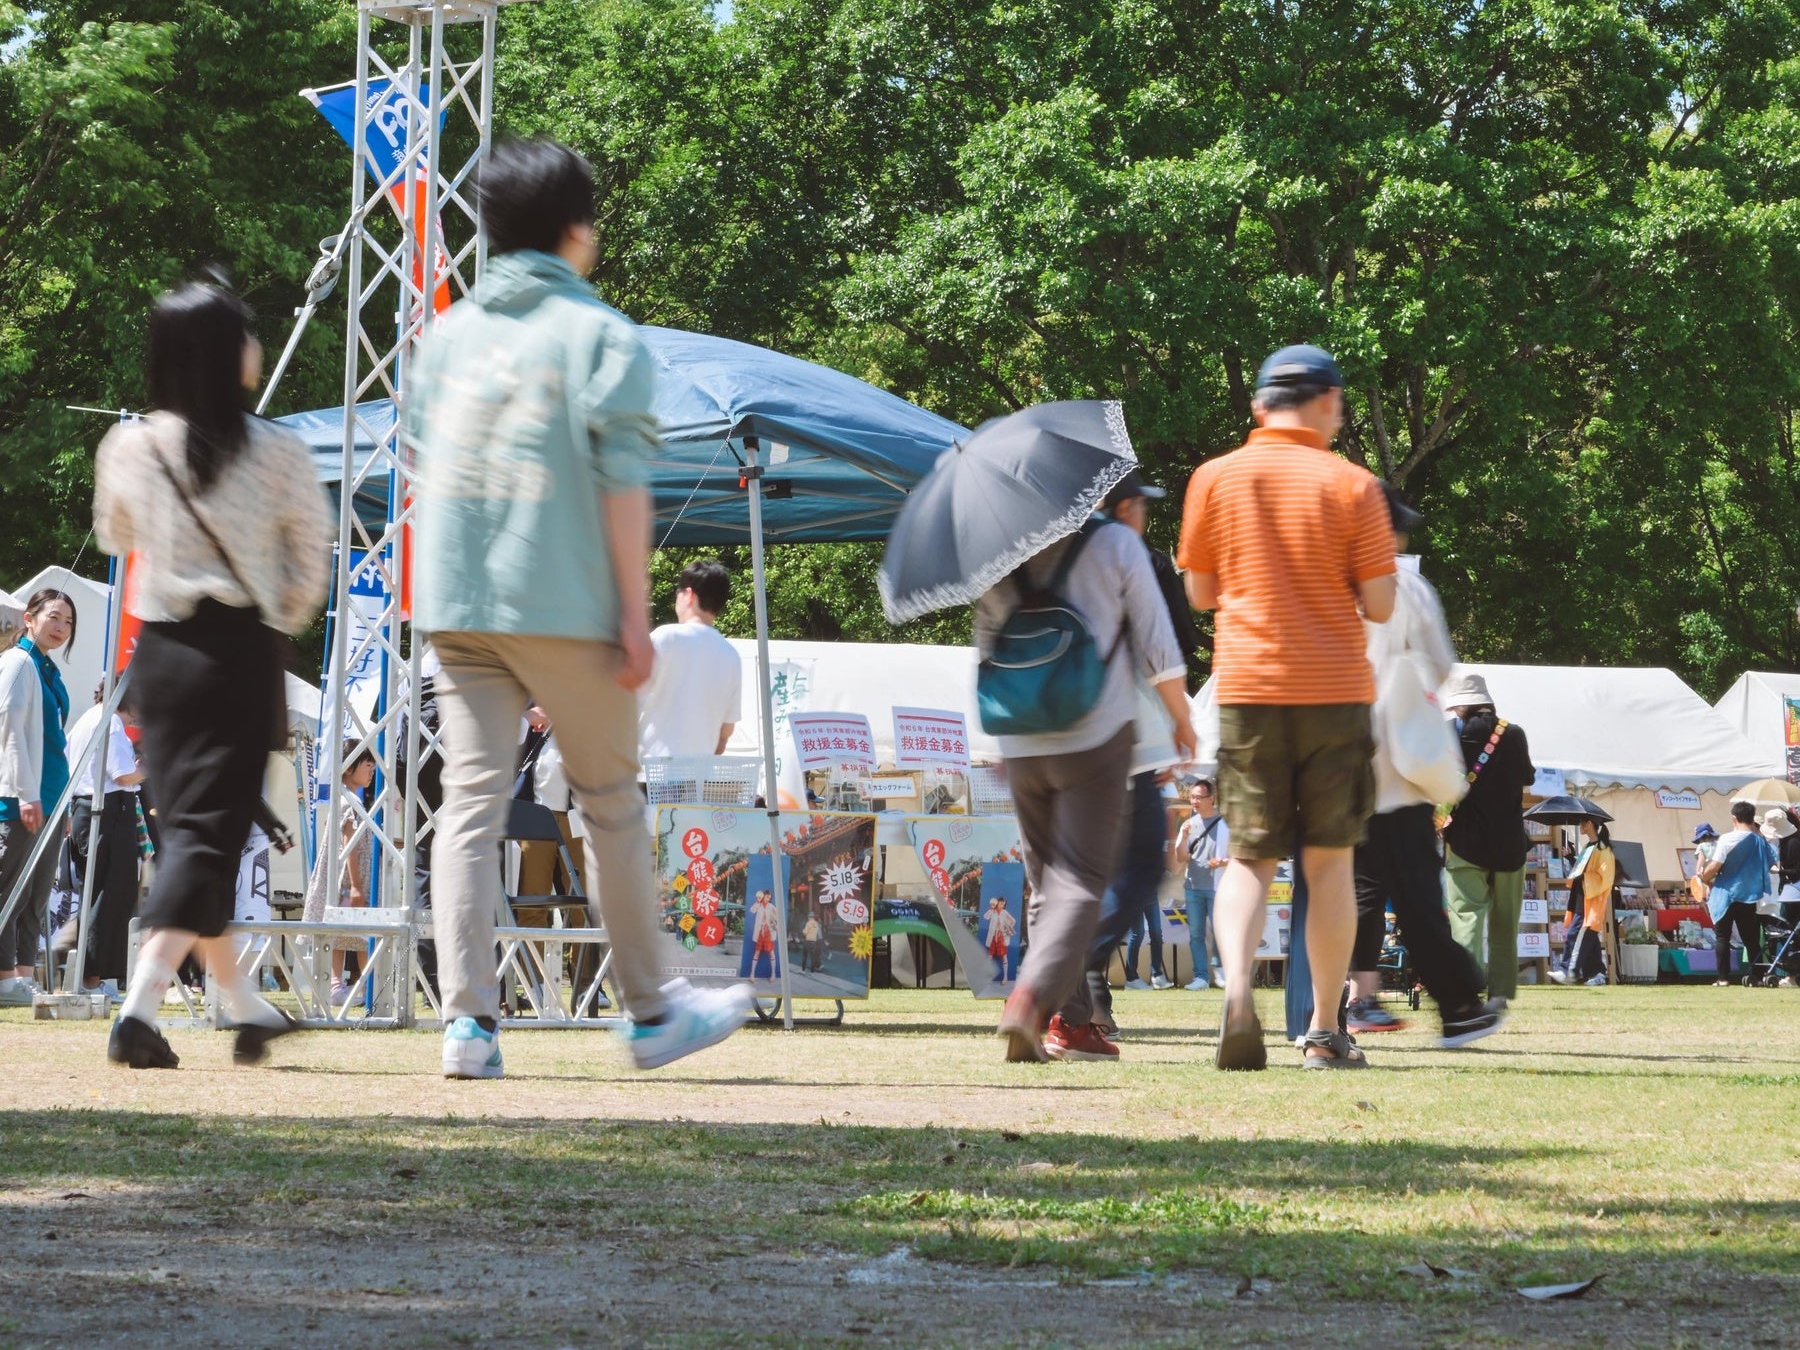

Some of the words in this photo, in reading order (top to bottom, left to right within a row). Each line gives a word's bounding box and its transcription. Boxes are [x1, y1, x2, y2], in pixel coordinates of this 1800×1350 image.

[802, 737, 870, 753] 救援金募金
[901, 736, 965, 754] 救援金募金
[830, 871, 853, 888] 5.18
[842, 901, 865, 919] 5.19
